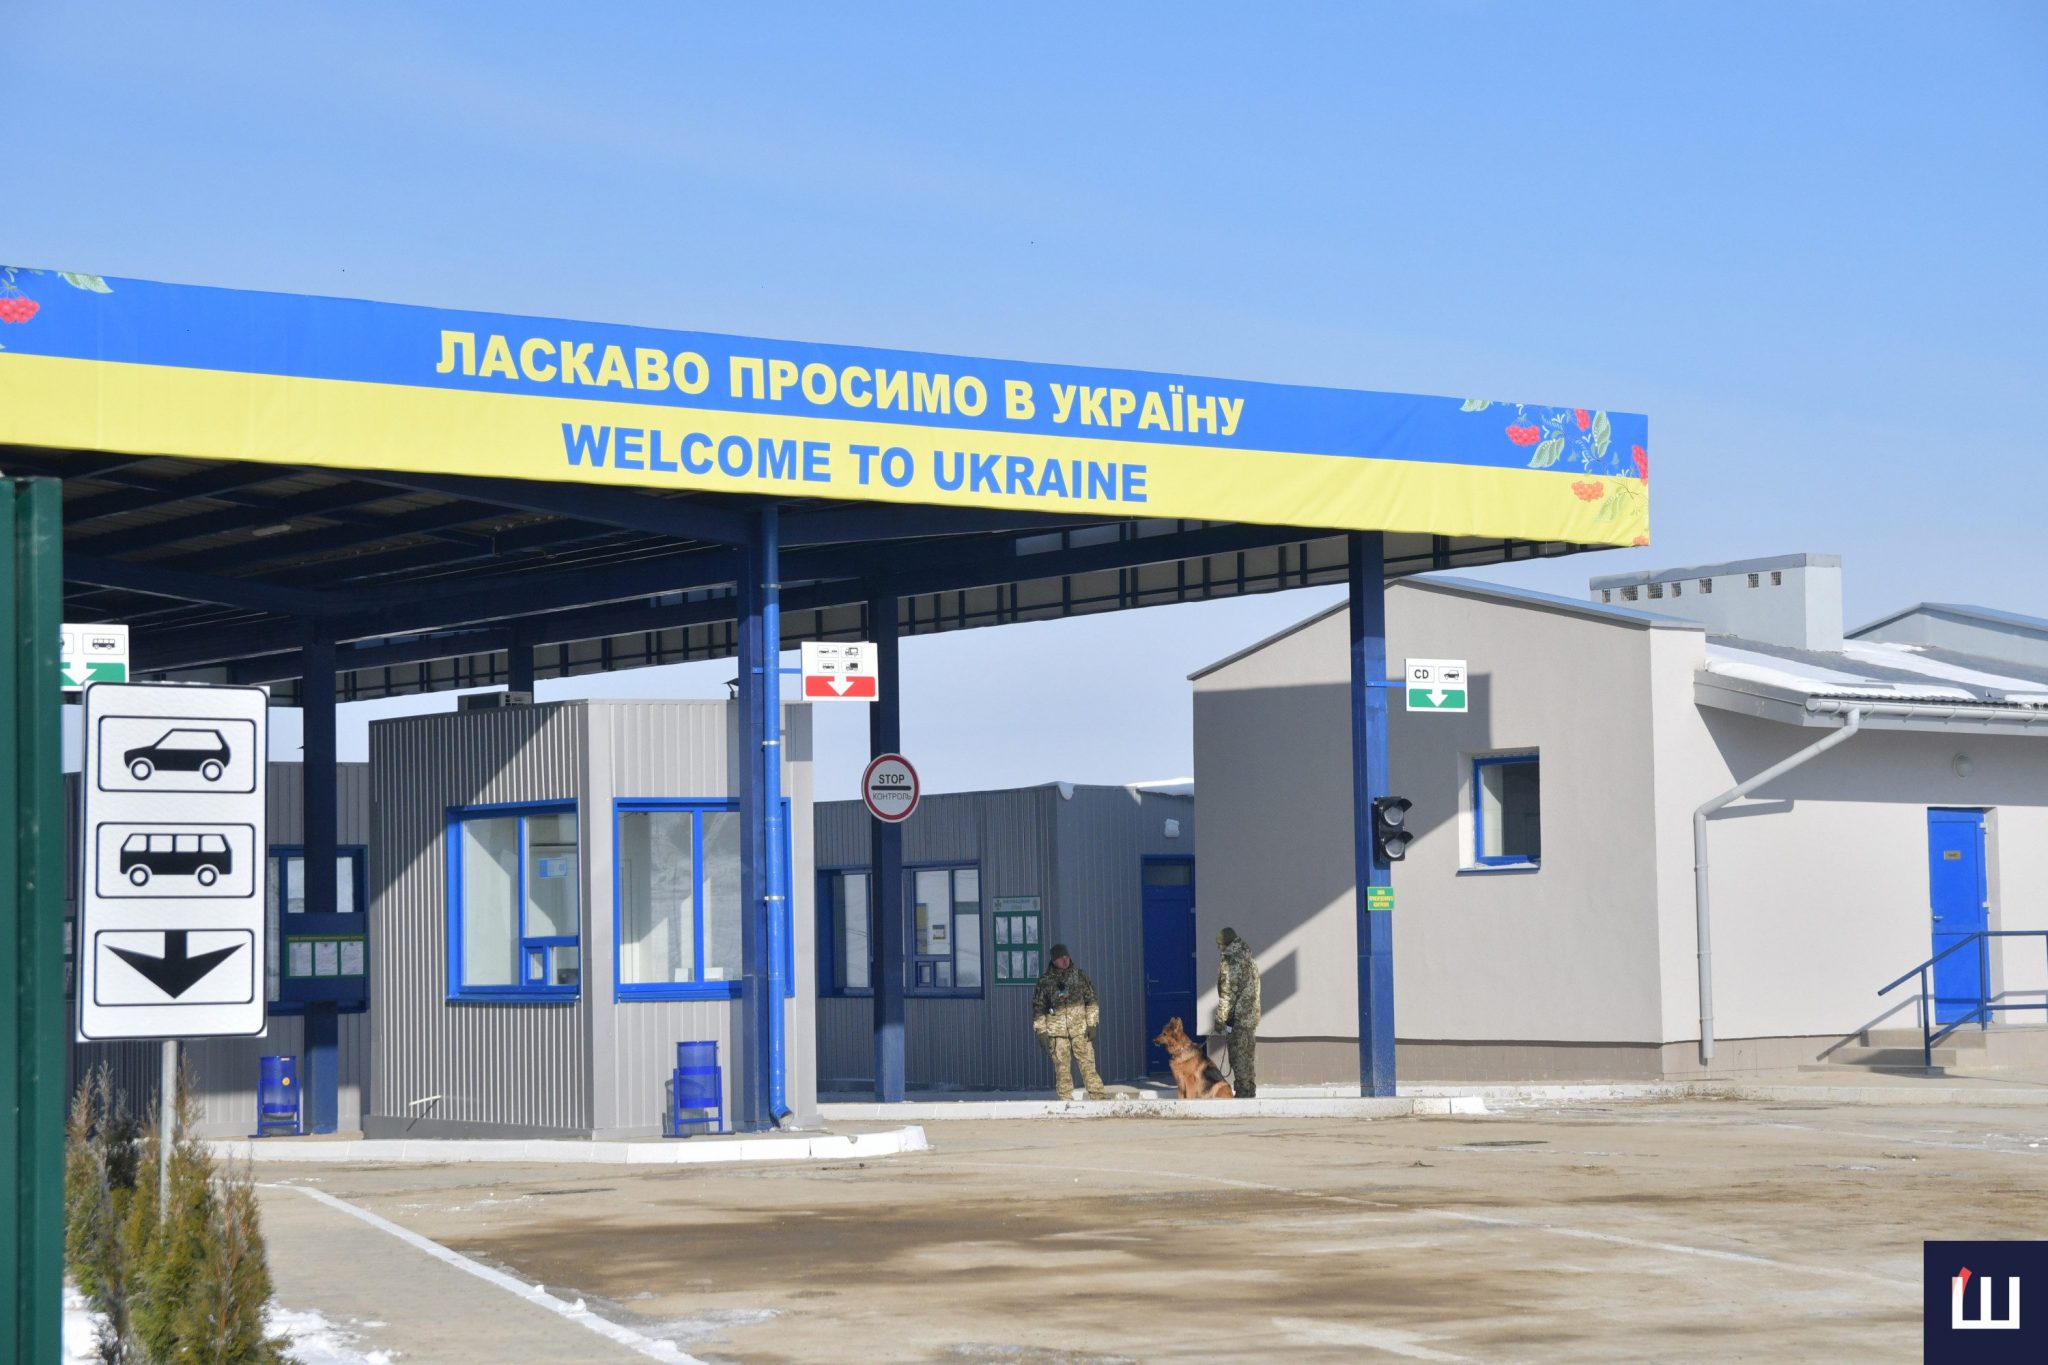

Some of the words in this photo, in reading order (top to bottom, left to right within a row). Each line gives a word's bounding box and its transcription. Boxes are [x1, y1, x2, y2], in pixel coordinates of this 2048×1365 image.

[436, 330, 709, 394] ЛАСКАВО
[730, 356, 988, 416] ПРОСИМО
[1005, 380, 1035, 420] В
[1051, 383, 1246, 437] УКРАЇНУ
[561, 422, 833, 484] WELCOME
[848, 443, 915, 489] TO
[933, 449, 1149, 504] UKRAINE
[1414, 669, 1429, 679] CD
[878, 774, 905, 784] STOP
[872, 792, 912, 801] КОНТРОЛЬ
